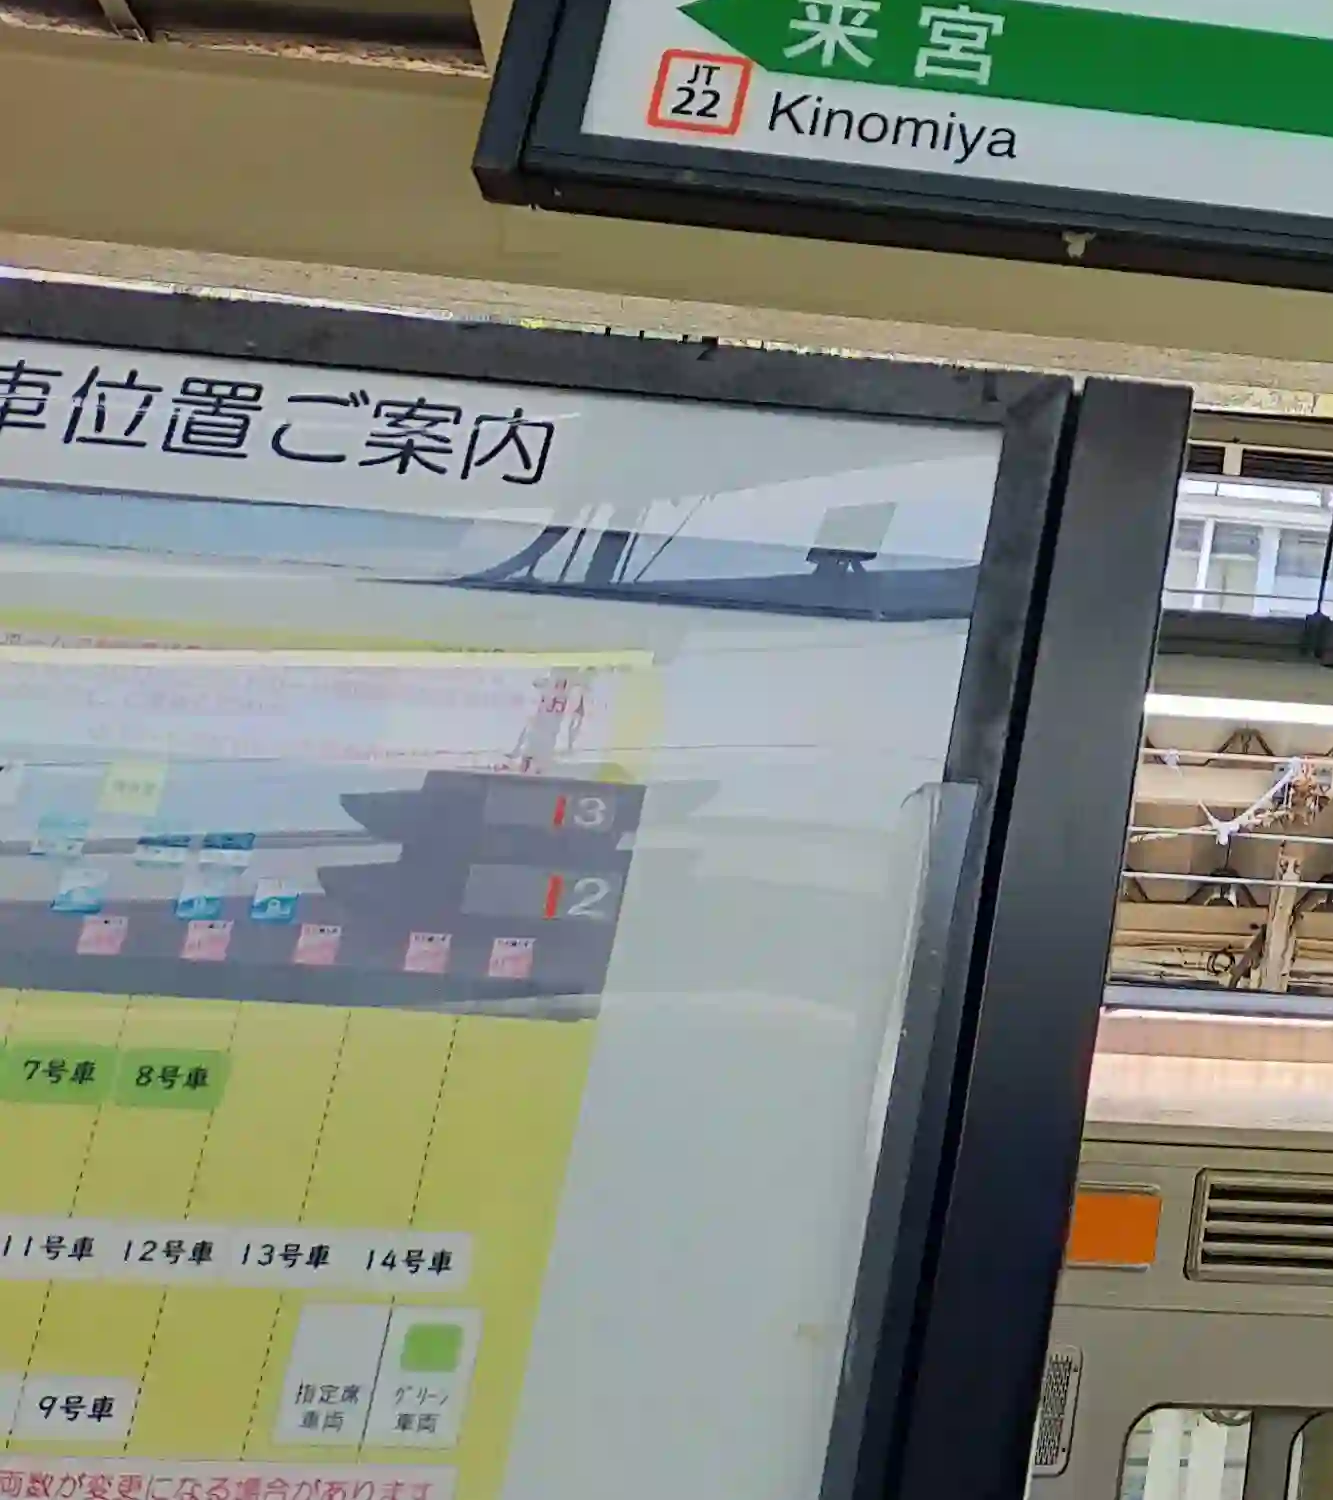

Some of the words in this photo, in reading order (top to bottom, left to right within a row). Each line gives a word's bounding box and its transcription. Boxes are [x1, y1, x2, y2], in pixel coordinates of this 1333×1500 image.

[687, 65, 720, 87] JT
[672, 87, 720, 118] 22
[769, 92, 1017, 164] Kinomiya
[23, 1059, 96, 1085] 7号車
[135, 1065, 208, 1090] 8号車
[3, 1235, 95, 1261] 11号車
[123, 1239, 213, 1266] 12号車
[241, 1243, 330, 1269] 13号車
[366, 1248, 453, 1275] 14号車
[38, 1395, 114, 1423] 9号車
